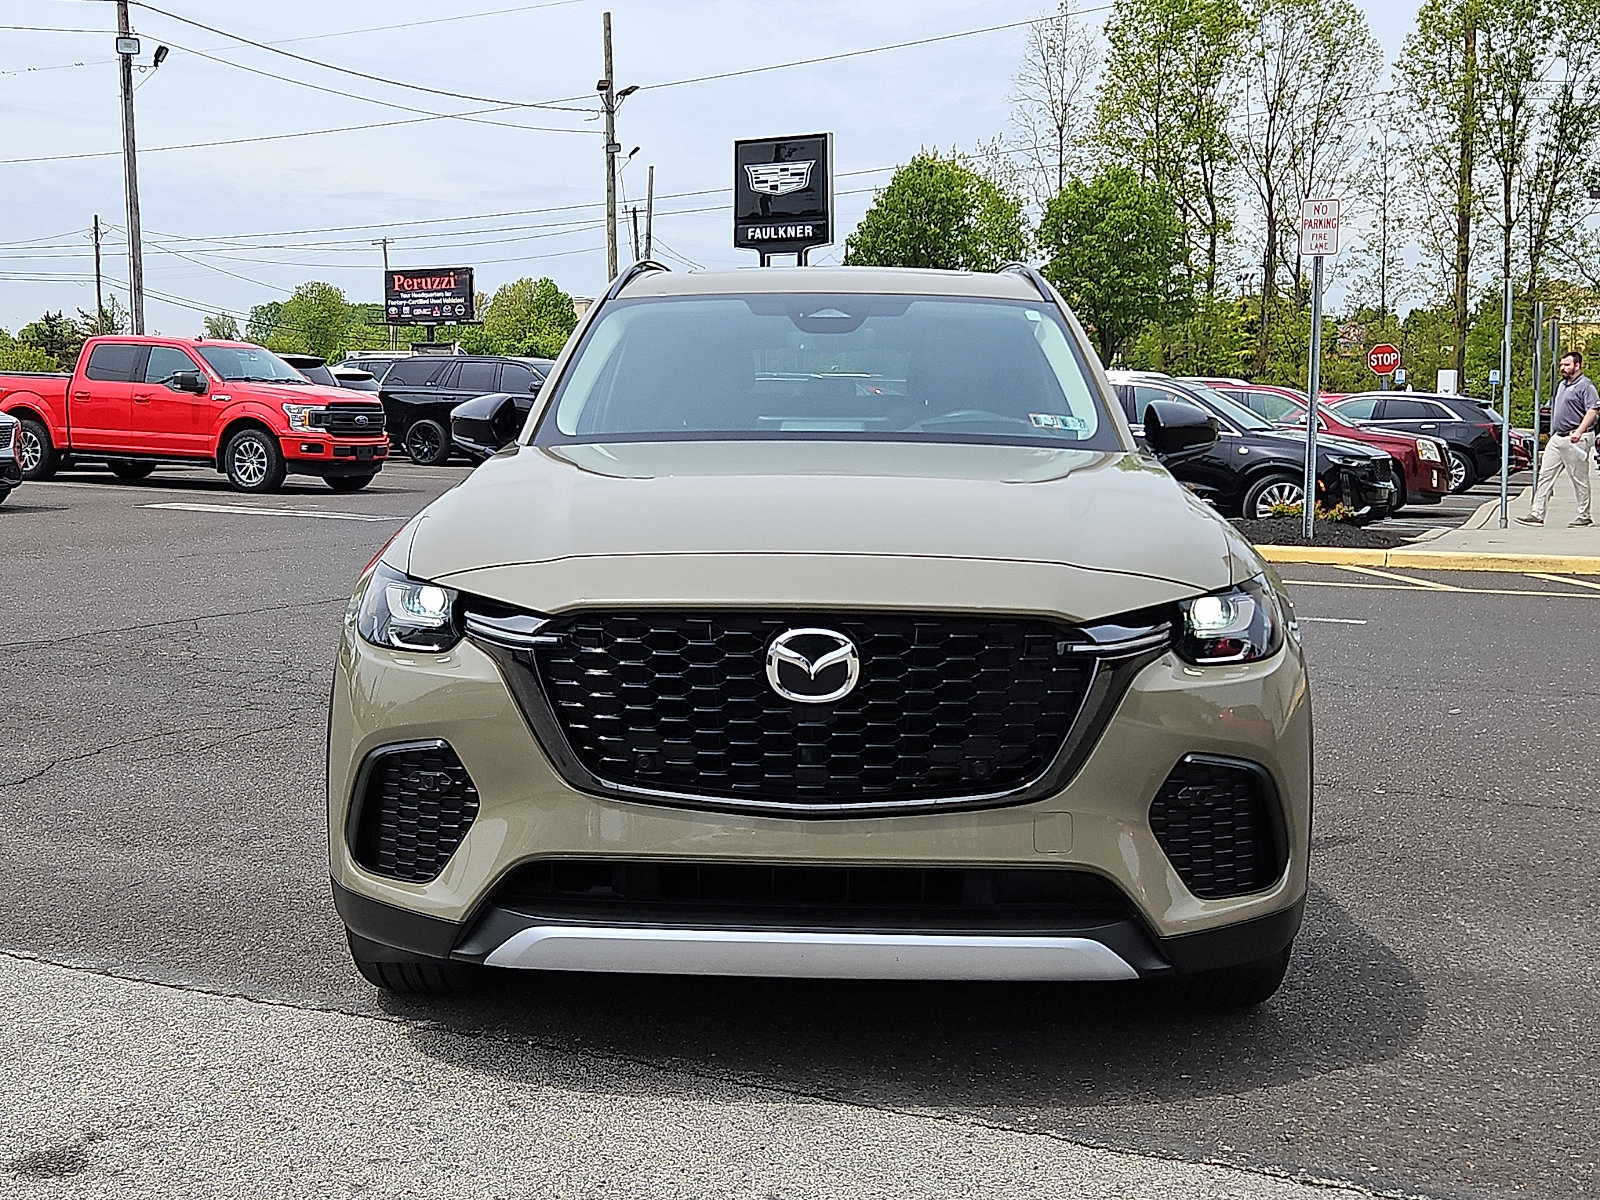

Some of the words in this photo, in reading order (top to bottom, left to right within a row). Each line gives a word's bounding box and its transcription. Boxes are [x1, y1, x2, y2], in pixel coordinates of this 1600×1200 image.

[1314, 204, 1328, 215] NO
[1304, 218, 1336, 229] PARKING
[748, 226, 812, 239] FAULKNER
[393, 272, 456, 291] Peruzzi
[1371, 353, 1397, 366] STOP
